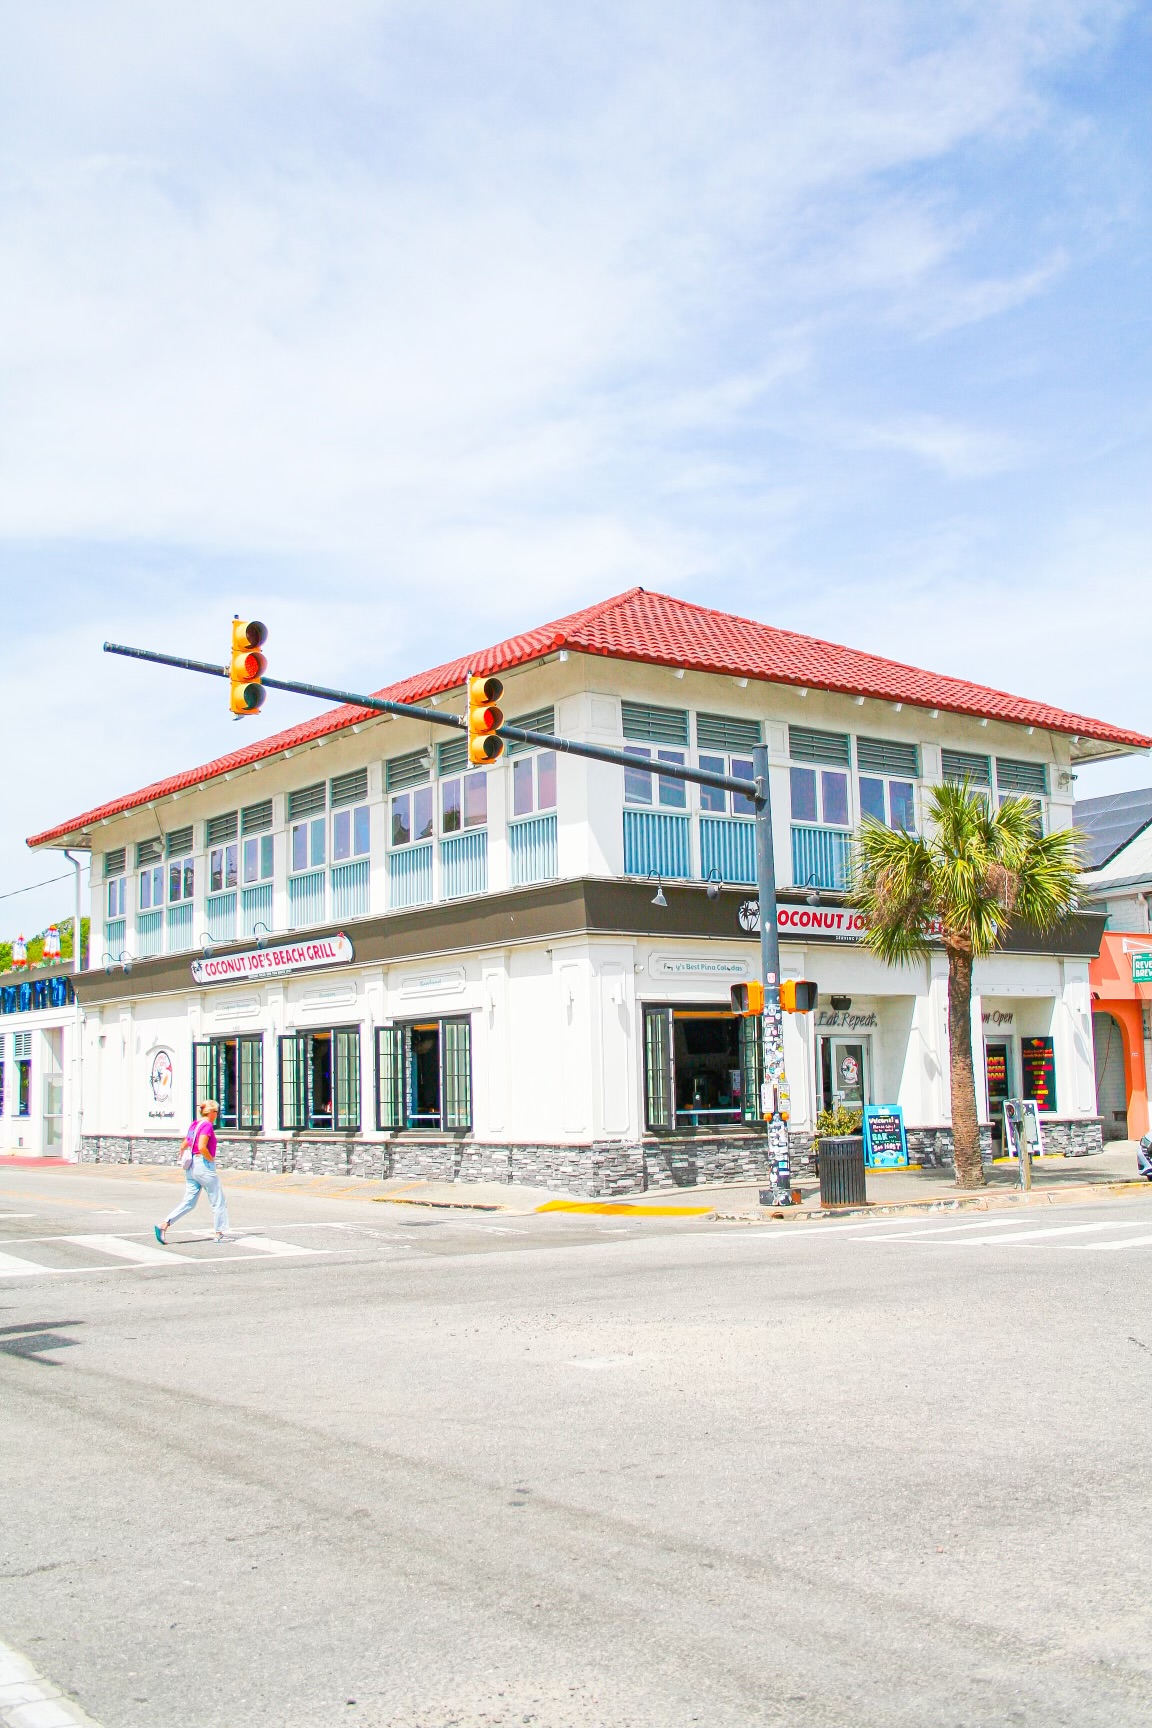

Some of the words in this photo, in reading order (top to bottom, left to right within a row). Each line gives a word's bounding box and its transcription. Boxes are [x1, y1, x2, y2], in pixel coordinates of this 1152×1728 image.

[777, 909, 844, 930] OCONUT
[205, 958, 246, 976] COCONUT
[248, 952, 272, 971] JOE'S
[273, 947, 306, 966] BEACH
[306, 943, 336, 960] GRILL
[993, 1010, 1014, 1027] Open
[871, 1132, 889, 1141] BAR
